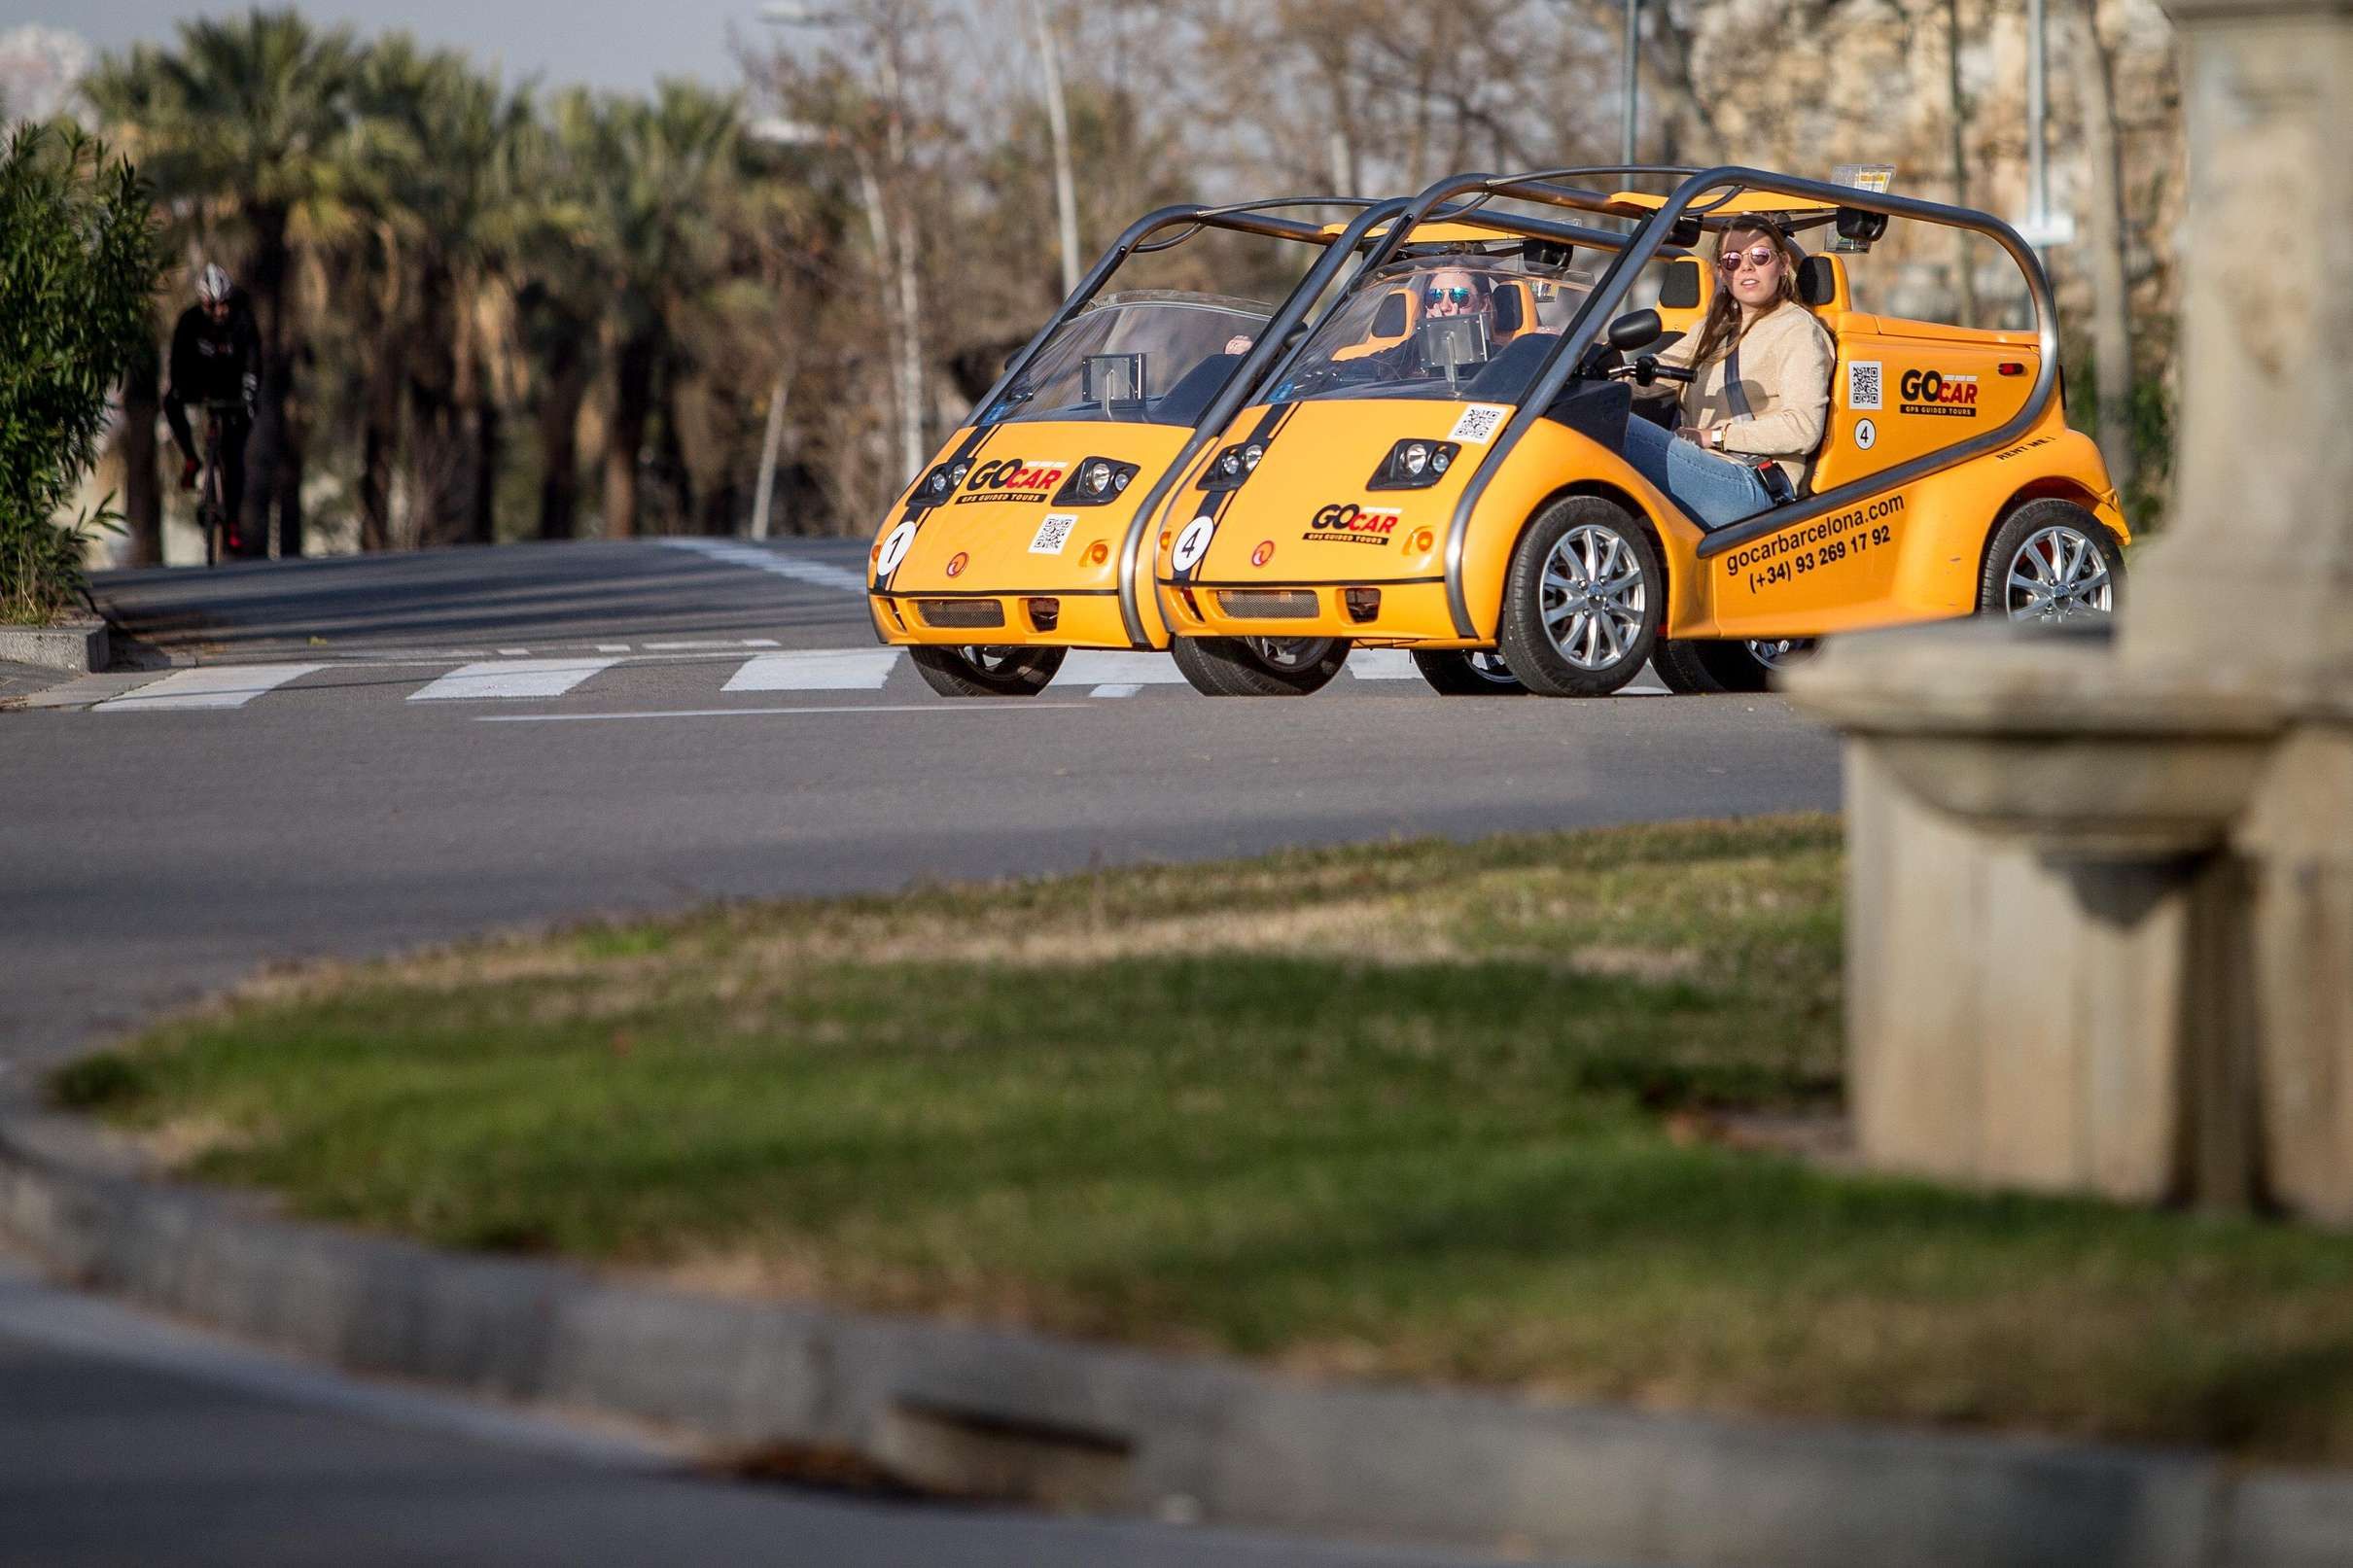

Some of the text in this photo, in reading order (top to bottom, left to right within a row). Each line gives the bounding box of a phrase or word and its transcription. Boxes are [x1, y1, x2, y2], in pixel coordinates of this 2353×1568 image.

[1901, 368, 1978, 404] GOCAR
[1860, 426, 1870, 443] 4
[1995, 445, 2028, 461] RENT
[966, 458, 1063, 491] GOCAR
[1312, 504, 1399, 534] GOCAR
[889, 532, 903, 563] 1
[1181, 528, 1201, 558] 4
[1727, 494, 1905, 576] gocarbarcelona.com
[1749, 525, 1891, 594] (+34) 93 269 17 92
